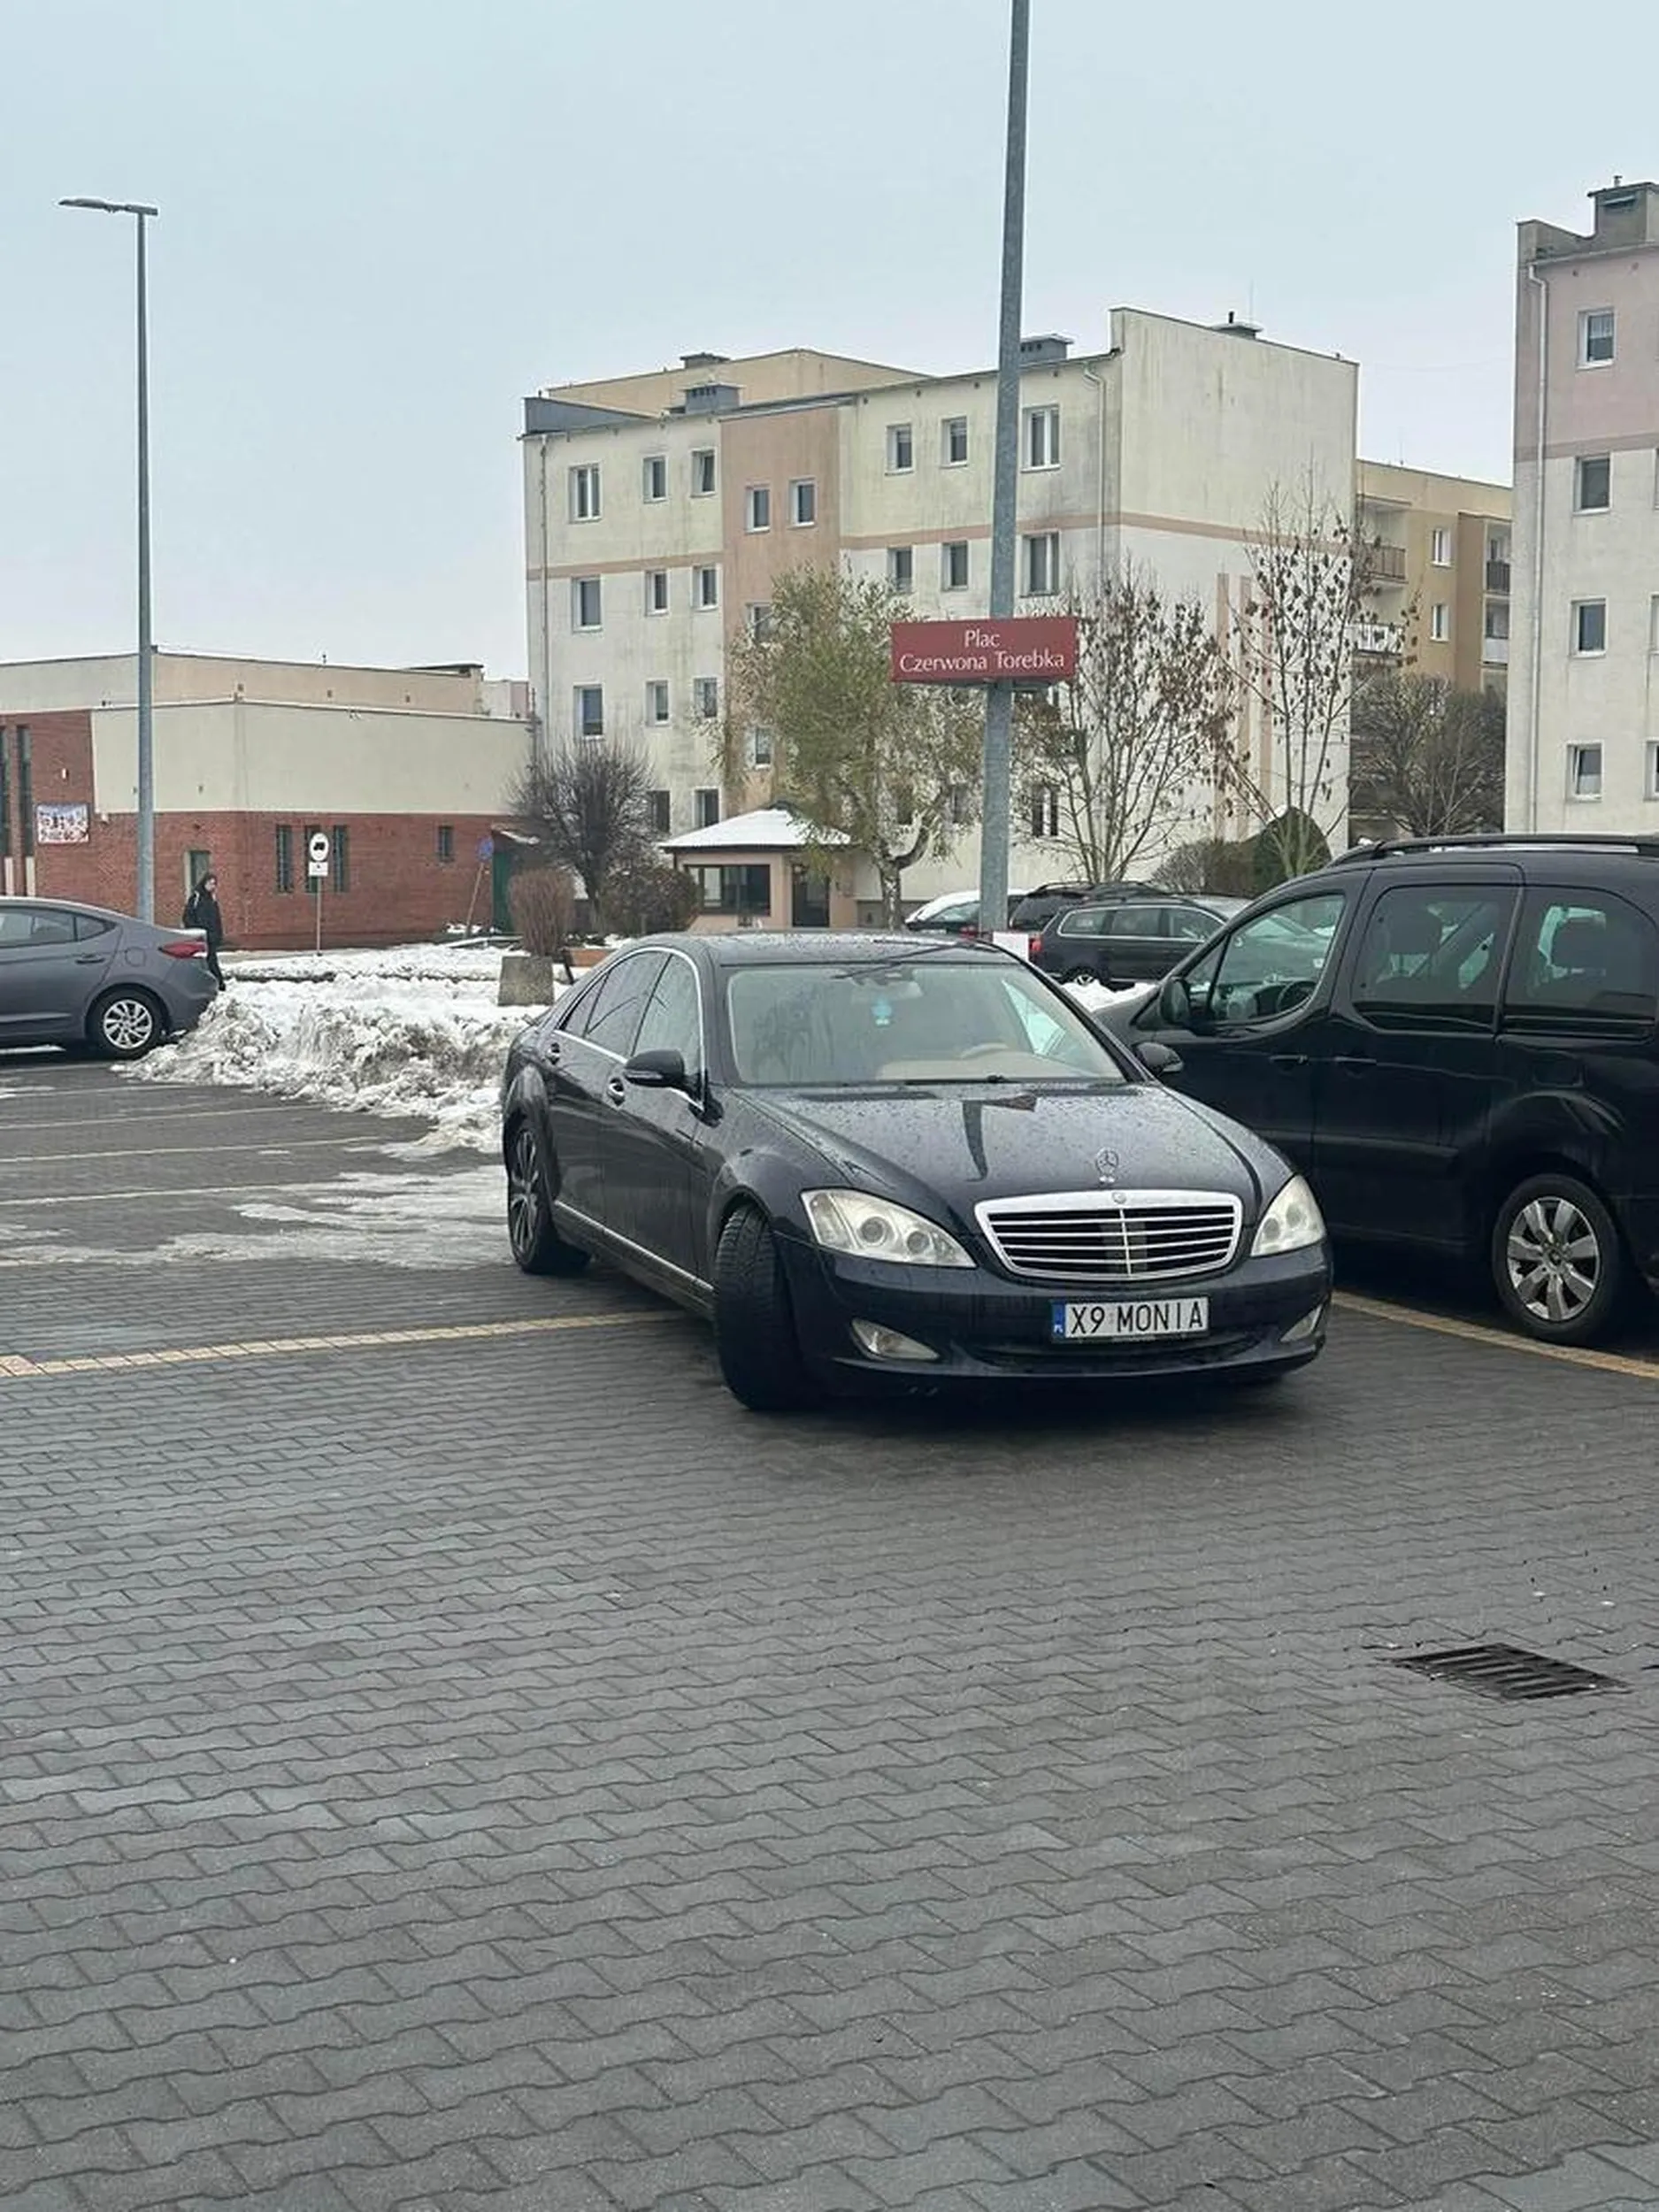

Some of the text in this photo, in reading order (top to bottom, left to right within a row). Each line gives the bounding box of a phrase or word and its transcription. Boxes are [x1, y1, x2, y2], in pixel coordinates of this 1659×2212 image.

[964, 629, 1002, 649] Plac
[899, 648, 1065, 672] Czerwona Torebka
[1071, 1300, 1204, 1335] X9 MONIA
